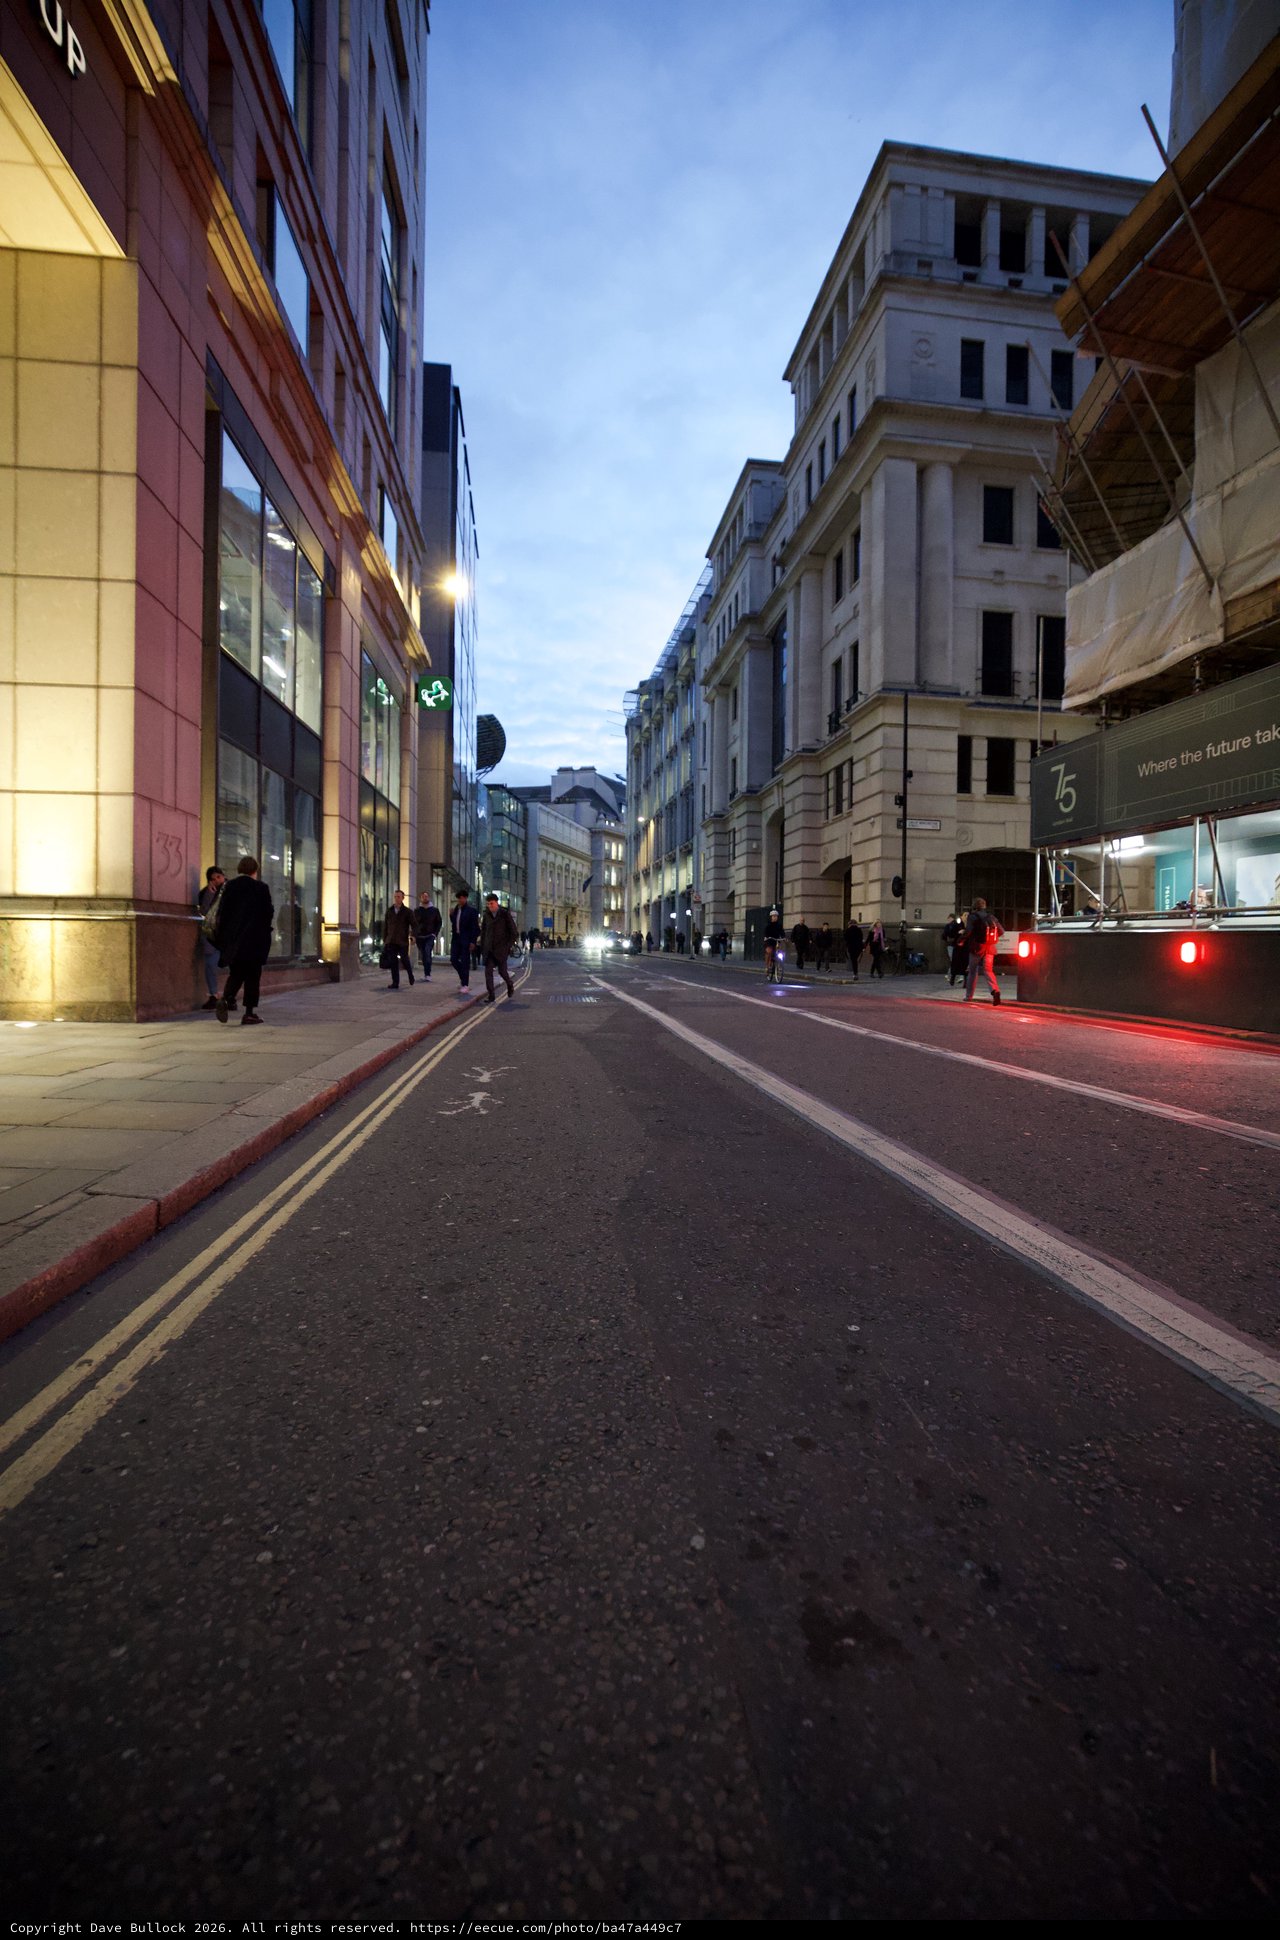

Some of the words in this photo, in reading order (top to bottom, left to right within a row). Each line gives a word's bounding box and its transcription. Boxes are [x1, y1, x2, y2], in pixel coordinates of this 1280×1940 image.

[1137, 758, 1177, 778] Where
[1180, 750, 1203, 766] the
[1205, 736, 1252, 759] future
[1255, 724, 1280, 745] tak
[1050, 762, 1077, 813] 75
[156, 831, 183, 879] 33
